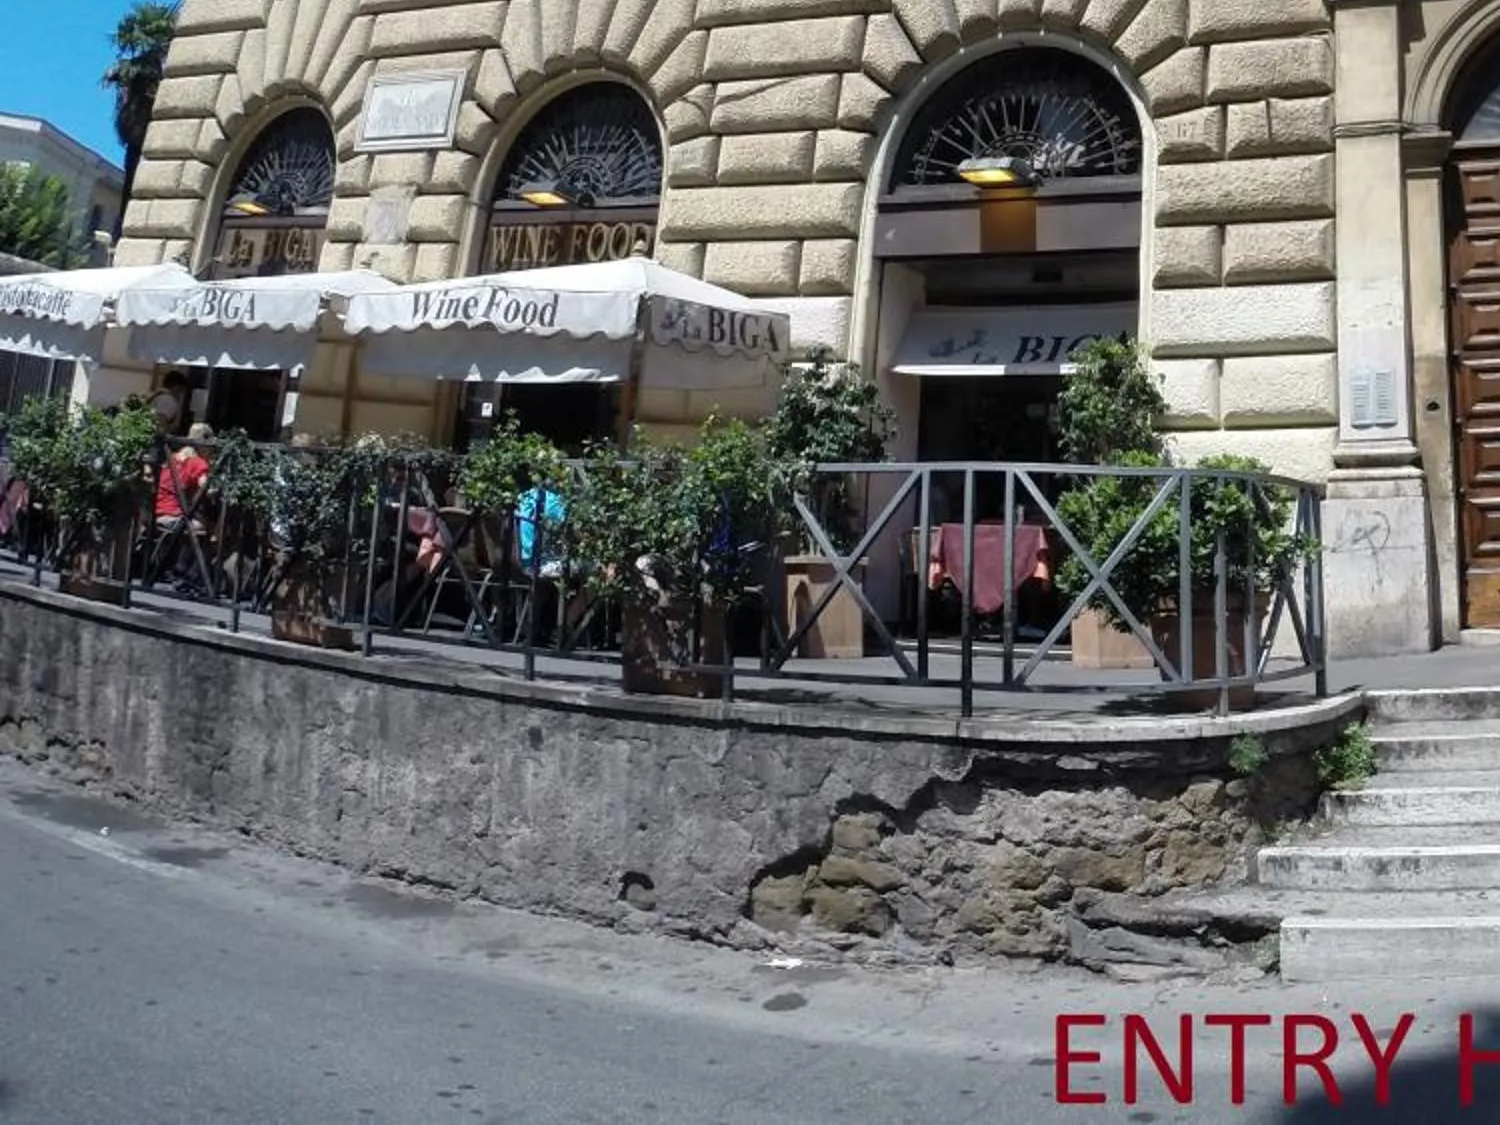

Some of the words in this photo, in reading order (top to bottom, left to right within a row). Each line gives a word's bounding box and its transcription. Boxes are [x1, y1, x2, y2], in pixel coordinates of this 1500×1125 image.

[228, 229, 255, 268] La
[263, 227, 317, 271] BIGA
[490, 225, 561, 272] WINE
[570, 222, 651, 263] FOOD
[201, 287, 256, 321] BIGA
[411, 279, 480, 322] Wine
[481, 285, 560, 328] Food
[708, 307, 780, 353] BIGA
